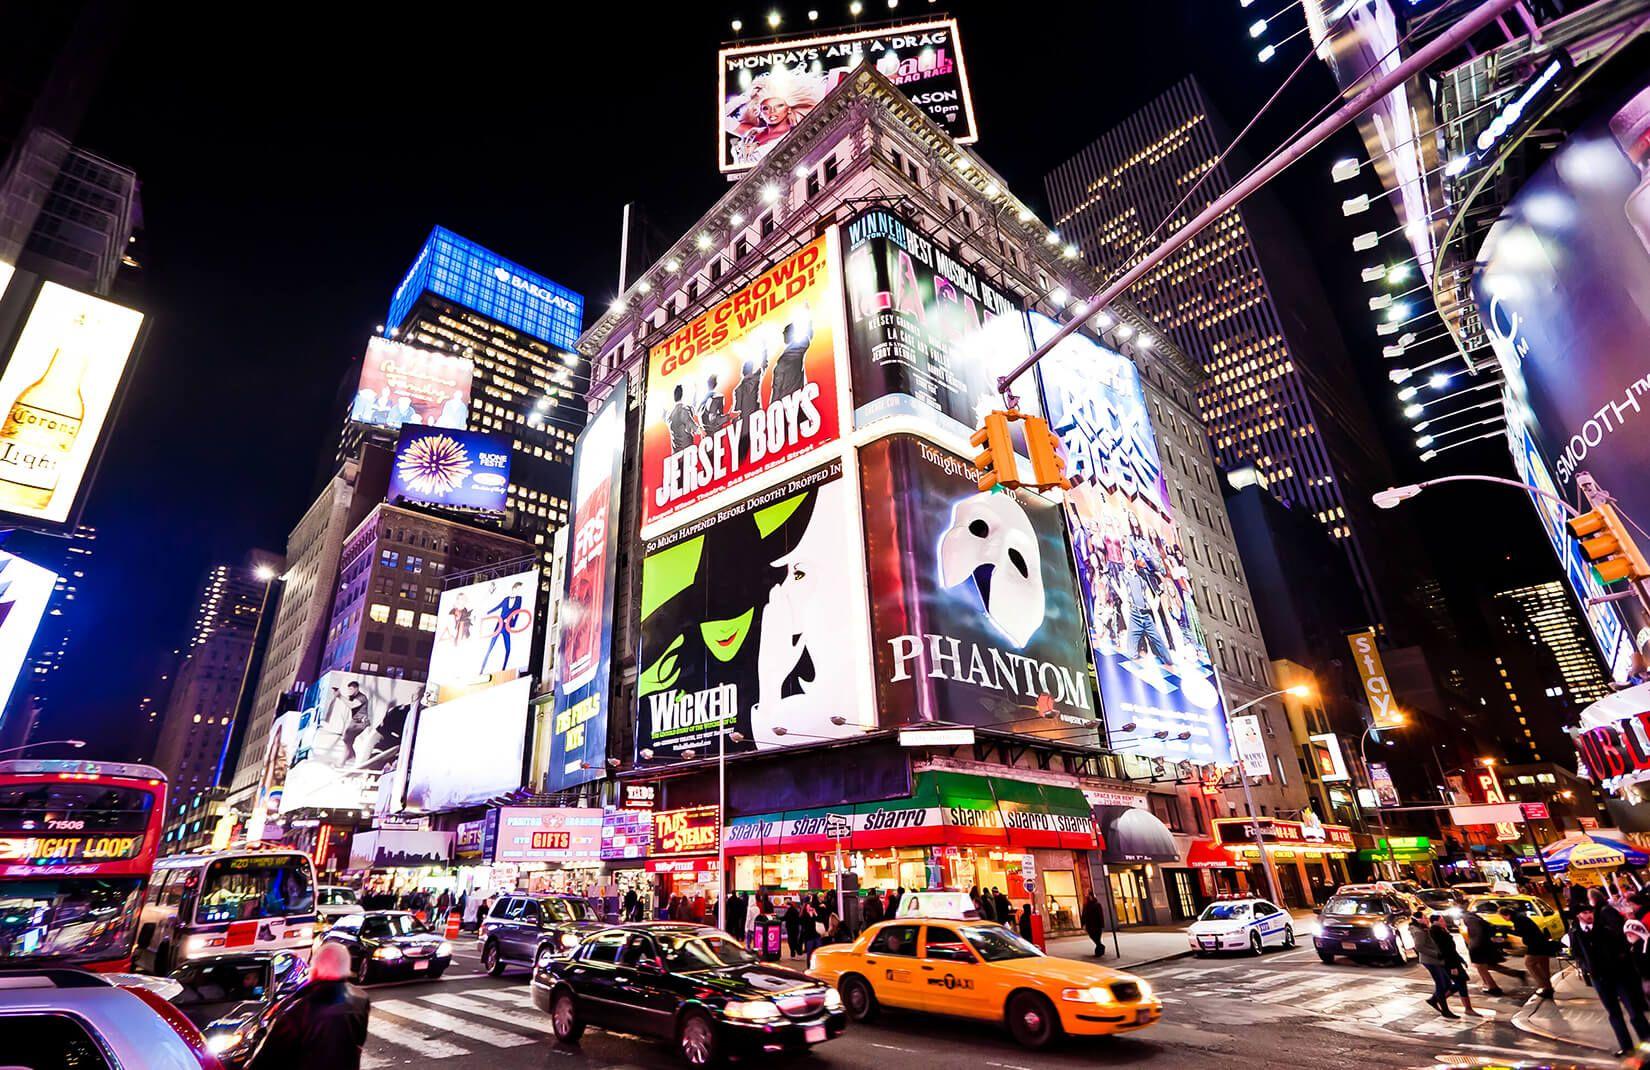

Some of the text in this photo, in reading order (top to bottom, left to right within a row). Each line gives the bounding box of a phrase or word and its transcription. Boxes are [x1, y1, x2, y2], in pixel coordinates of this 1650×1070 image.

[728, 31, 947, 71] MONDAYS ARE A DRAG
[911, 90, 957, 104] ASON
[928, 105, 959, 114] 10pm
[849, 212, 906, 247] WINNER!
[905, 227, 934, 269] BEST
[935, 248, 981, 301] MUSICAL
[511, 276, 576, 313] BARCLAYS
[714, 246, 819, 325] CROWD
[868, 314, 894, 331] KELSEY
[887, 327, 898, 341] LA
[661, 323, 729, 377] GOES
[0, 442, 57, 470] Ligh
[655, 382, 821, 508] JERSEY BOYS
[918, 441, 963, 477] Tonight
[887, 633, 1091, 710] PHANTOM
[863, 807, 926, 830] sbarro
[951, 807, 996, 827] sbarro
[1008, 810, 1049, 831] sbarro
[82, 837, 133, 858] LOOP
[533, 832, 569, 848] GIFTS
[675, 826, 715, 851] STEAKS
[1575, 854, 1623, 867] SABRETT
